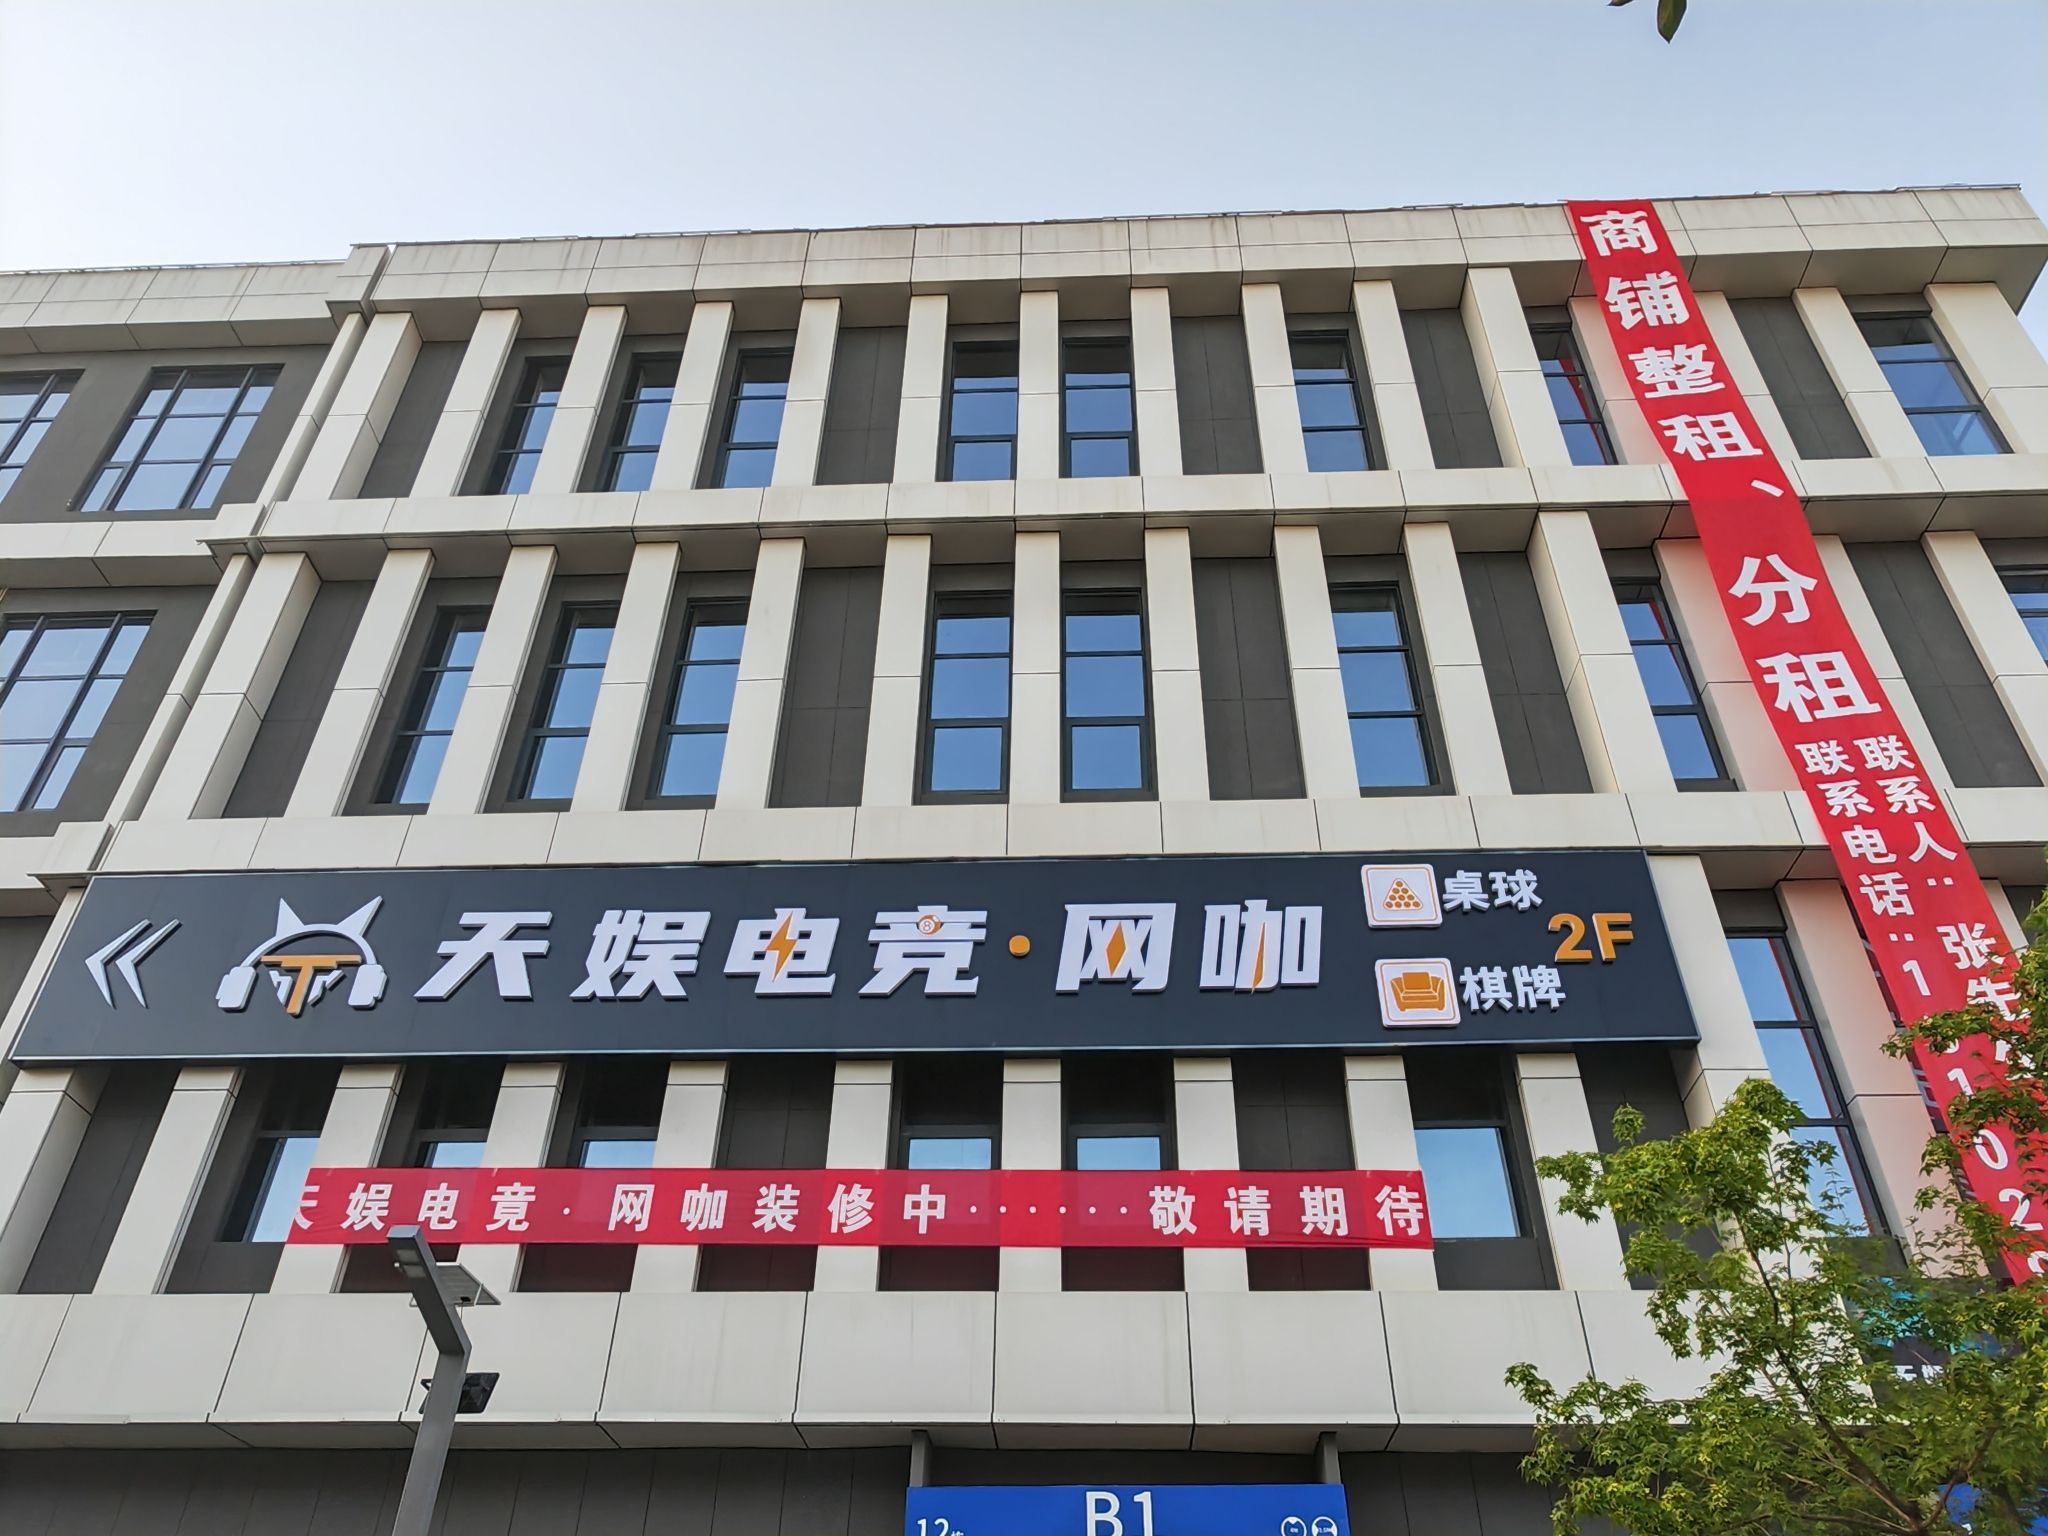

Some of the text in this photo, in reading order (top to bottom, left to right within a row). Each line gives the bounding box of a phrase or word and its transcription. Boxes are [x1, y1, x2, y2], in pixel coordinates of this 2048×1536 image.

[1442, 869, 1543, 912] 桌球
[1548, 912, 1634, 962] 2F
[1459, 965, 1566, 1011] 棋牌
[1086, 1491, 1153, 1536] B1
